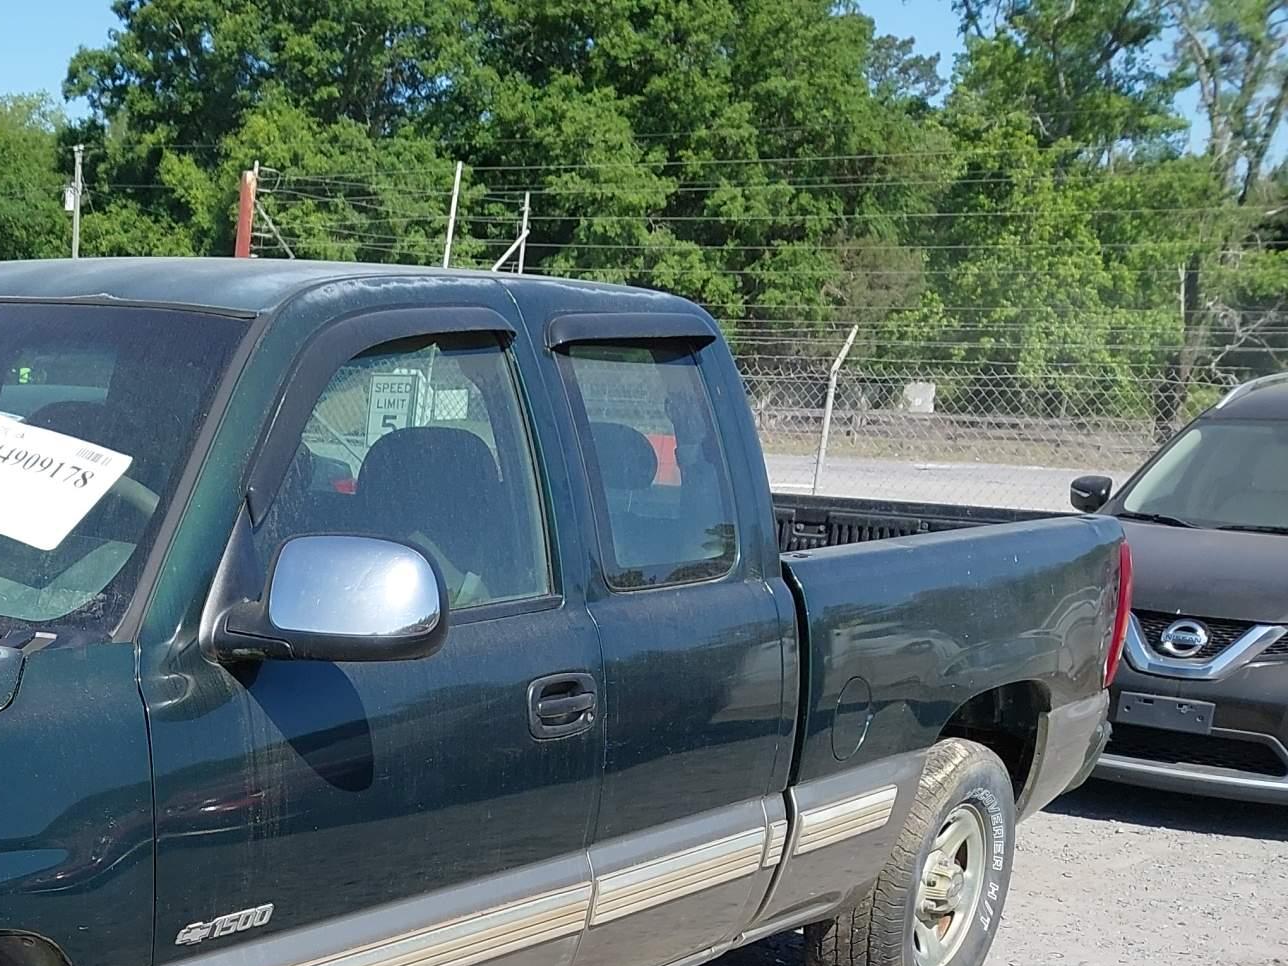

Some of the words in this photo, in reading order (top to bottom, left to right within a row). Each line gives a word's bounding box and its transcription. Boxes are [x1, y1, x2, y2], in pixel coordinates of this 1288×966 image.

[374, 382, 413, 394] SPEED
[376, 397, 407, 409] LIMIT
[381, 414, 398, 431] 5
[212, 903, 274, 938] 1500
